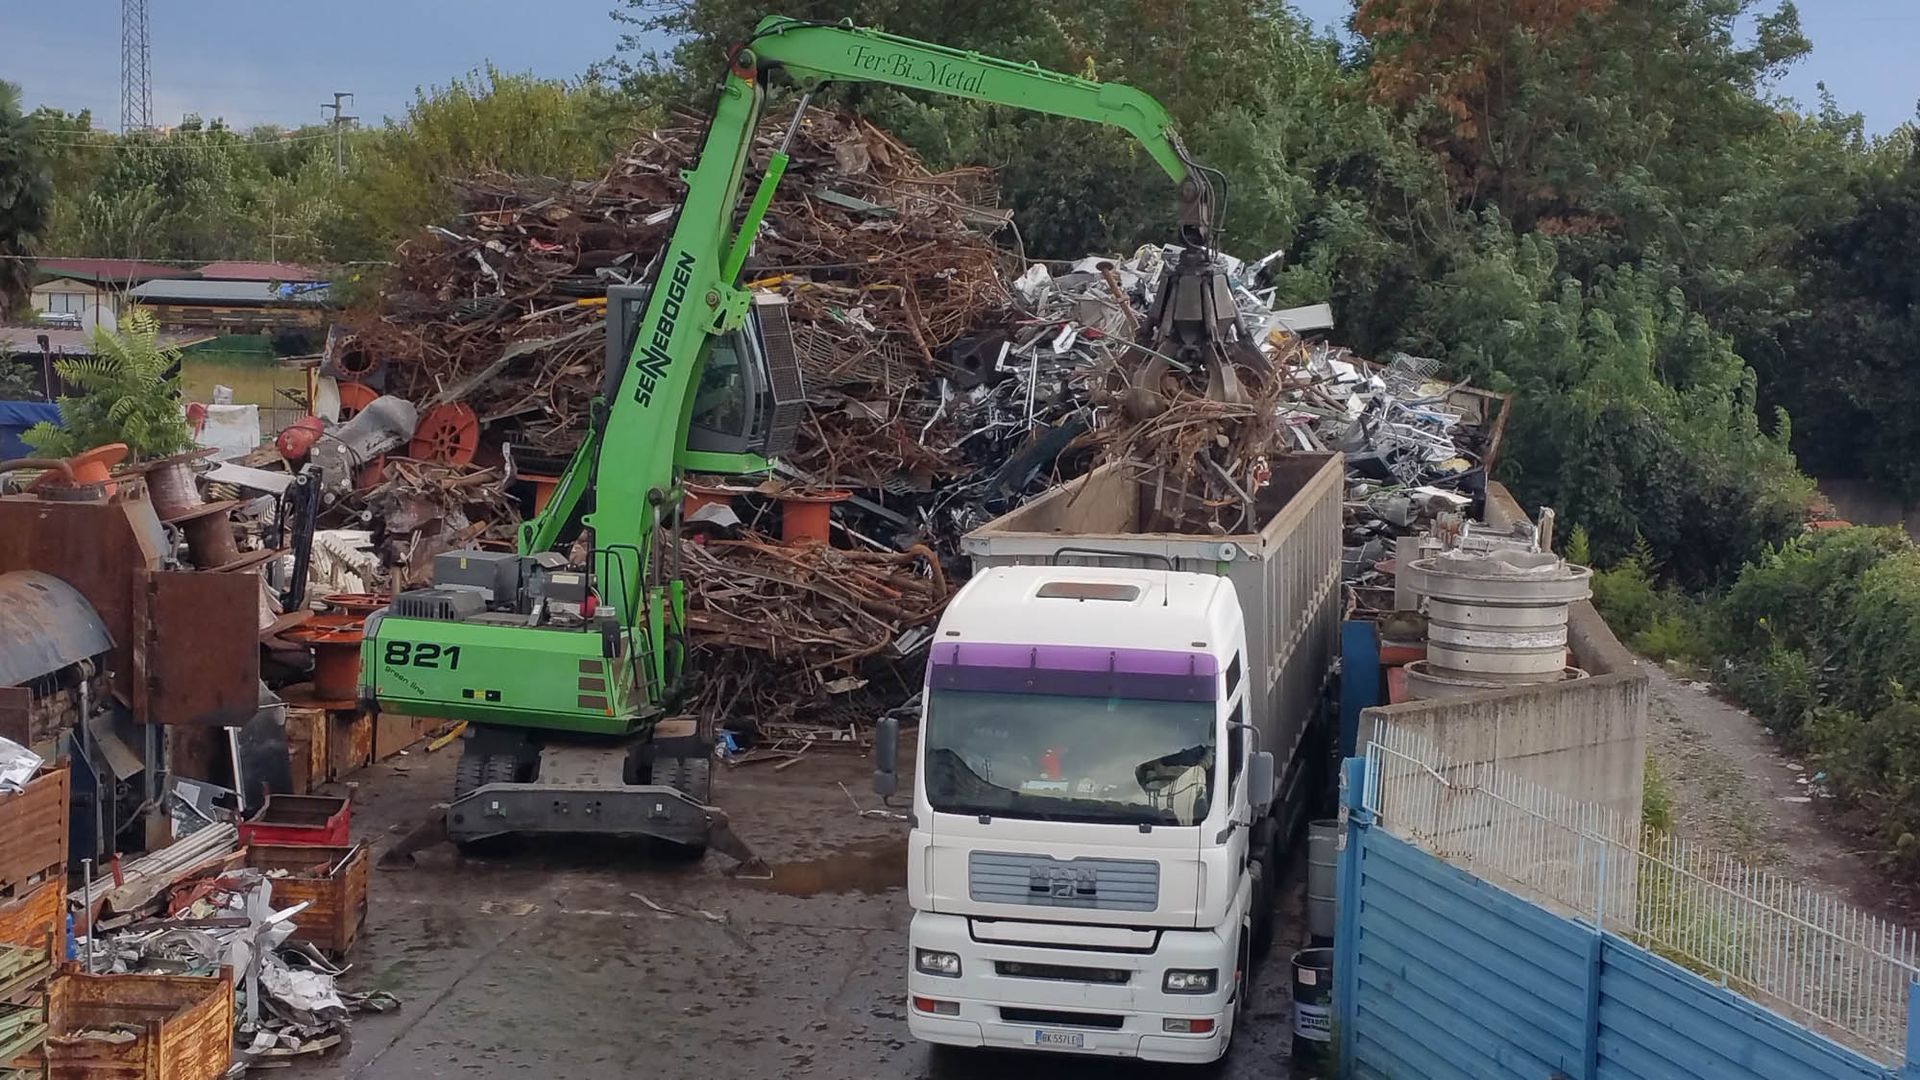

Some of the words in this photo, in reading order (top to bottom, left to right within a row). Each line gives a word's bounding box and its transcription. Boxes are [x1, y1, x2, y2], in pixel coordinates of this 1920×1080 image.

[634, 250, 697, 408] SENNEBOGEN
[384, 640, 462, 670] 821
[384, 665, 409, 685] green
[410, 681, 425, 696] line
